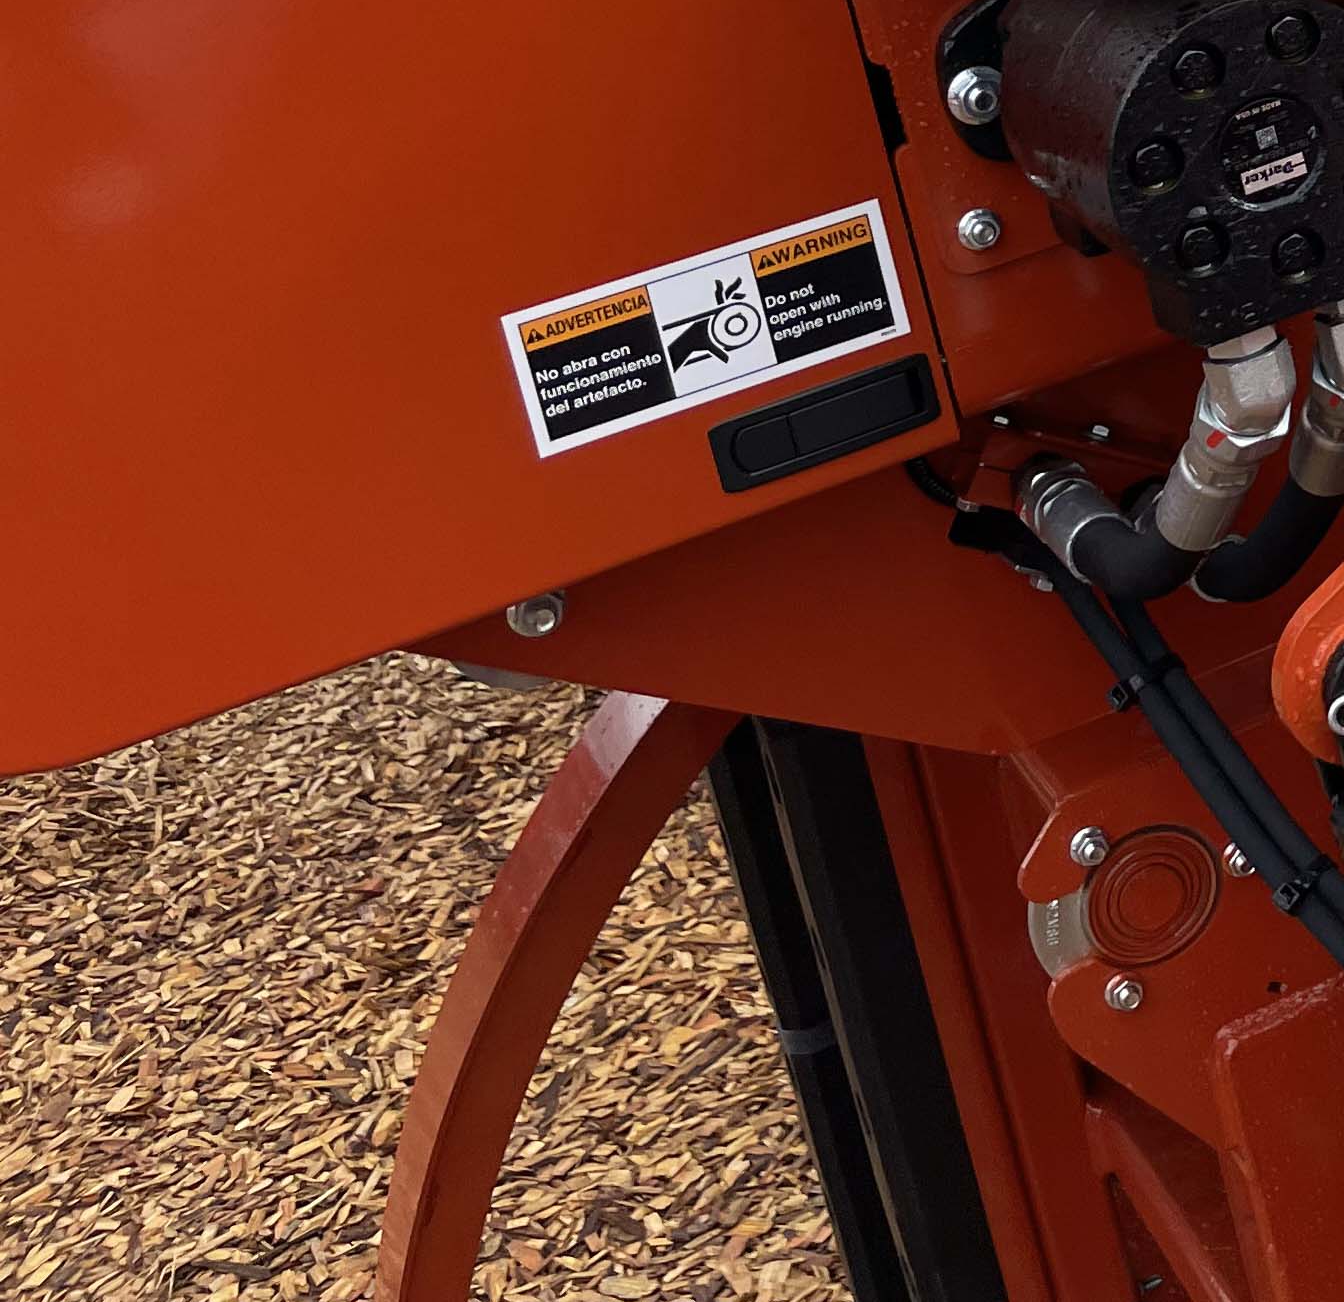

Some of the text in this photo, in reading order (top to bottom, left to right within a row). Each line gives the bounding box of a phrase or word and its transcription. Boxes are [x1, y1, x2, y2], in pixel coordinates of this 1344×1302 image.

[1244, 161, 1294, 185] Parker
[772, 223, 868, 264] WARNING
[546, 294, 648, 338] ADVERTENCIA
[764, 283, 815, 309] Do not
[769, 293, 841, 325] open with
[773, 297, 887, 341] engine running.
[535, 345, 631, 384] No abra con
[540, 353, 662, 400] funcionamiento
[545, 377, 647, 418] del artefacto.
